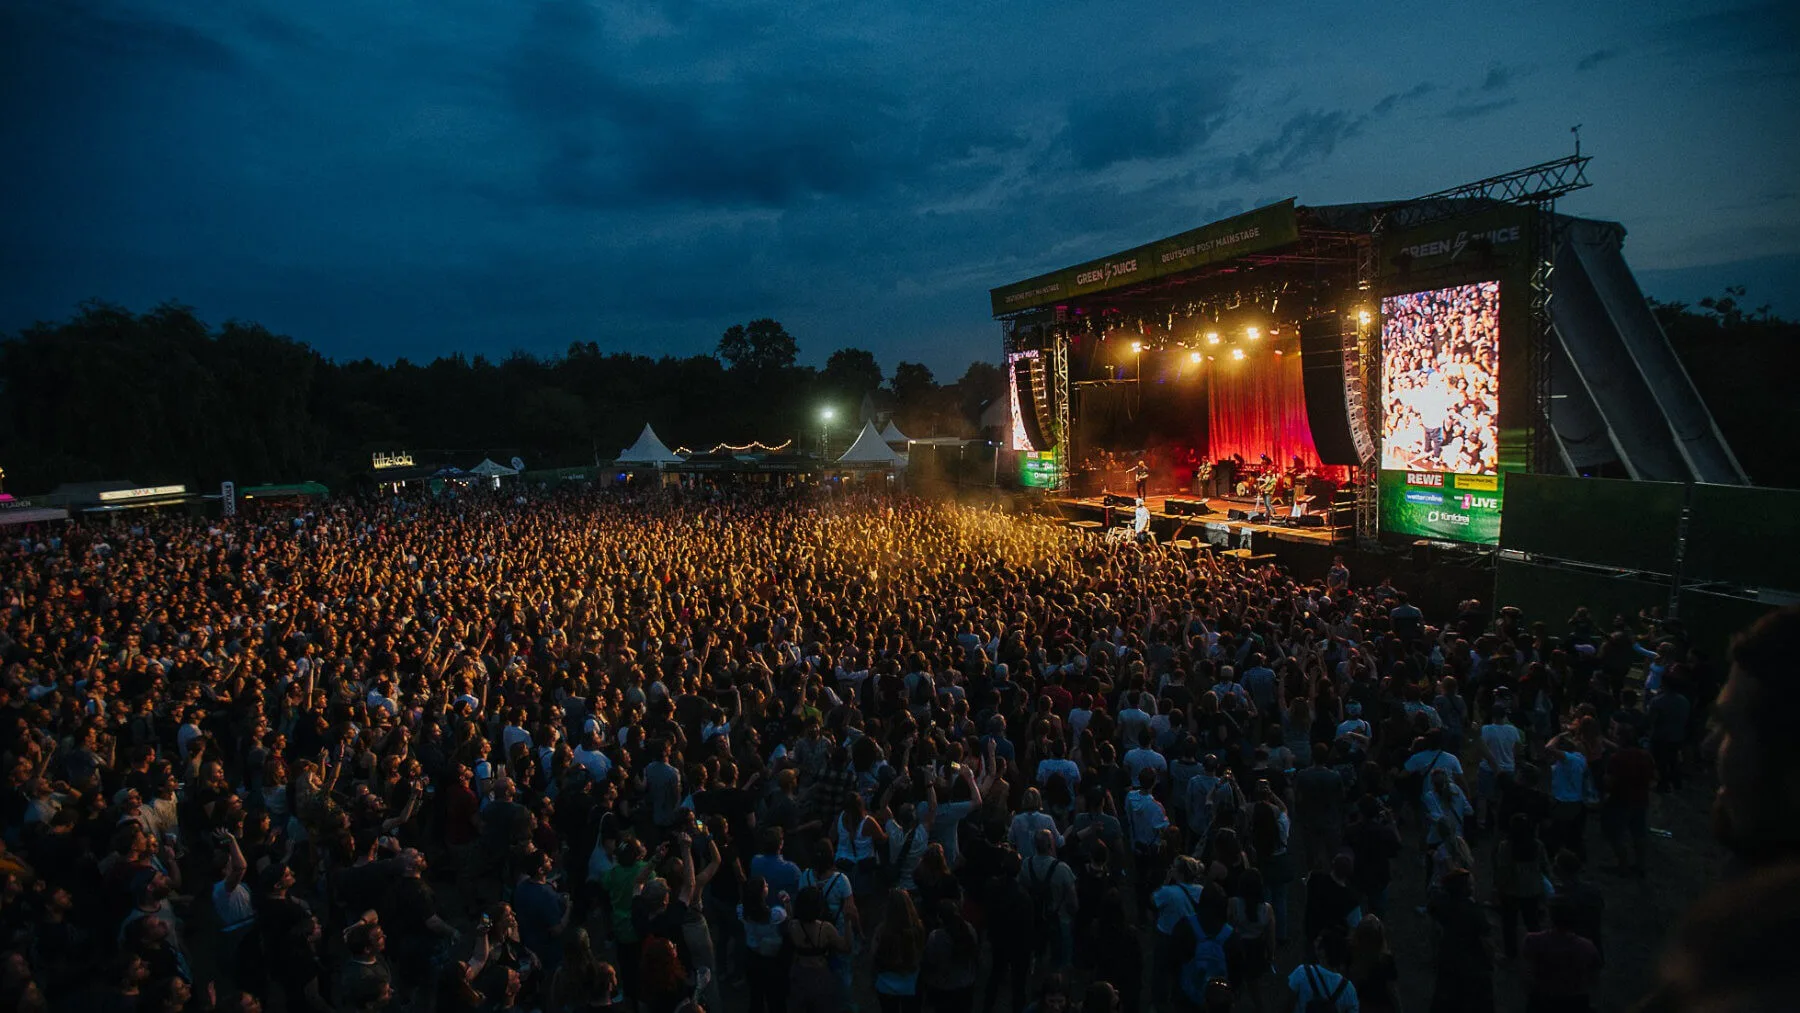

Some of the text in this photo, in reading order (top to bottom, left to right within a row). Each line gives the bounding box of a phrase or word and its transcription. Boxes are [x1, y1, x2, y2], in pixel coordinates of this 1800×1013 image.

[1161, 226, 1260, 263] DEUTSCHE POST MAINSTAGE
[1076, 259, 1137, 285] GREEN JUICE
[1407, 472, 1443, 486] REWE
